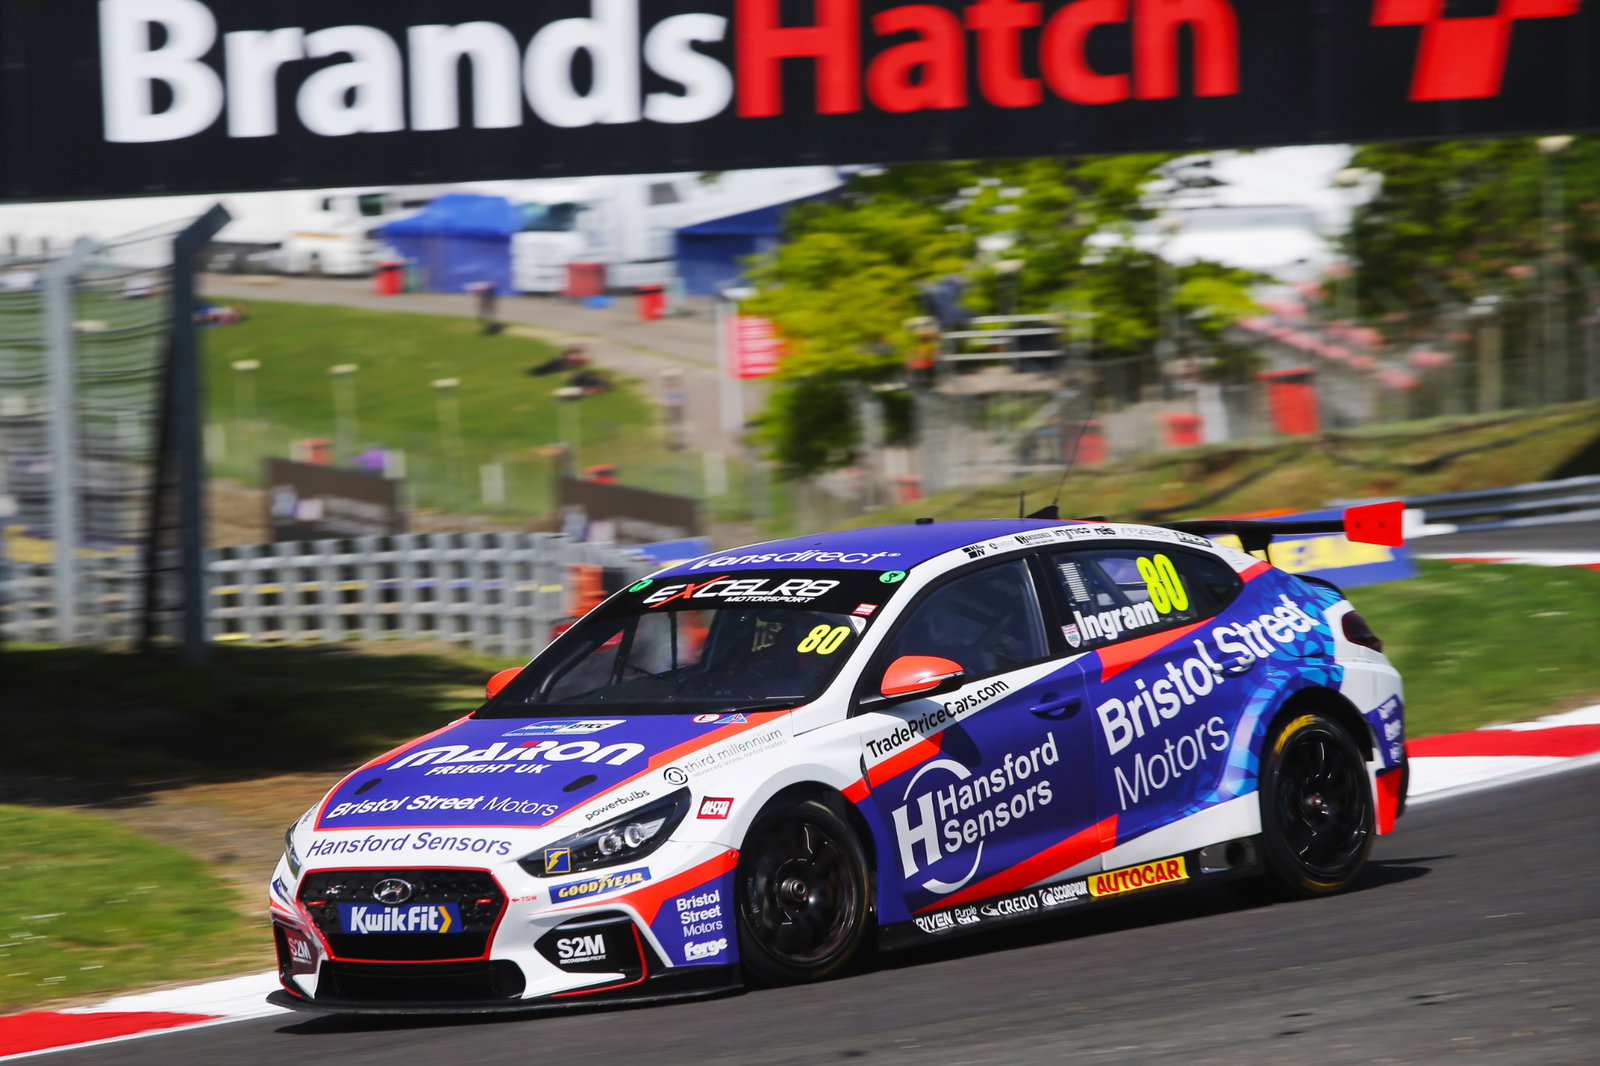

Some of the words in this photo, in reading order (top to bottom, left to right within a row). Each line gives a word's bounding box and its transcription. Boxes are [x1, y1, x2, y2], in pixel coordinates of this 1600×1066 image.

[643, 575, 840, 609] EXCELR8
[1136, 553, 1189, 615] 80
[724, 596, 816, 604] MOTORSPORT
[1072, 600, 1160, 641] Ingram
[796, 624, 851, 655] 80
[1096, 638, 1225, 755] Bristol
[1211, 593, 1320, 674] Street
[865, 679, 1010, 760] TradePriceCars.com
[685, 753, 716, 773] third
[717, 728, 783, 760] millennium
[1114, 715, 1230, 812] Motors
[424, 764, 517, 776] FREIGHT
[514, 764, 552, 774] UK
[937, 731, 1060, 821] Hansford
[325, 796, 411, 819] Bristol
[406, 795, 485, 810] Street
[481, 797, 559, 816] Motors
[585, 788, 650, 821] powerbulbs
[944, 779, 1053, 852] Sensors
[306, 834, 411, 858] Hansford
[411, 831, 512, 856] Sensors
[557, 871, 644, 898] GOODYEAR
[1052, 880, 1089, 901] SCORPION
[1095, 859, 1182, 895] AUTOCAR
[676, 889, 721, 912] Bristol
[954, 904, 978, 920] Purple
[997, 893, 1039, 915] CREDO
[680, 905, 722, 925] Street
[683, 919, 724, 938] Motors
[287, 936, 312, 960] S2M
[556, 934, 606, 959] S2M
